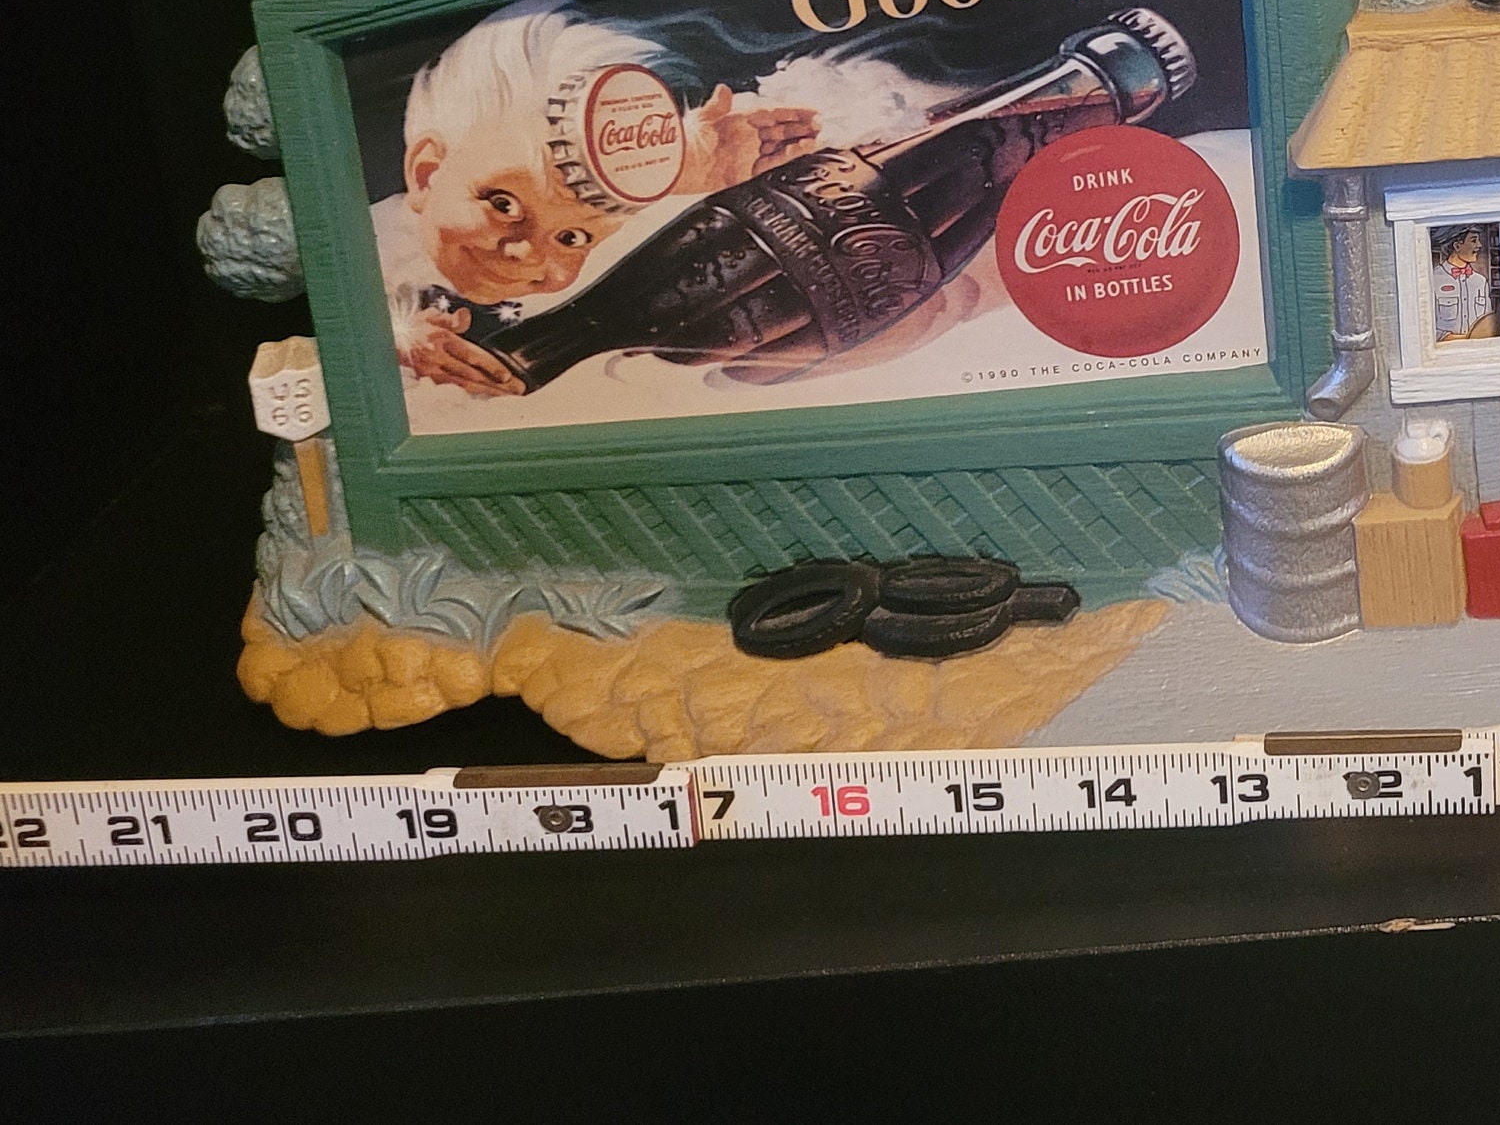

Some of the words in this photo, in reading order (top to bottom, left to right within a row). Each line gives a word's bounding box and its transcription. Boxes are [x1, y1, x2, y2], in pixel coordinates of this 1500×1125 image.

[598, 112, 678, 156] Coca-Cola
[1072, 167, 1134, 192] DRINK
[1014, 188, 1207, 274] Coca-Cola
[1066, 285, 1087, 302] IN
[1094, 274, 1174, 300] BOTTLES
[1030, 366, 1061, 376] THE
[1071, 355, 1172, 373] COCA-COLA
[1182, 346, 1262, 364] COMPANY
[0, 817, 51, 849] 2
[107, 814, 173, 847] 21
[243, 811, 323, 843] 20
[395, 808, 459, 839] 19
[810, 786, 871, 819] 16
[944, 782, 1005, 813] 15
[1077, 777, 1137, 809] 14
[1210, 773, 1270, 804] 13
